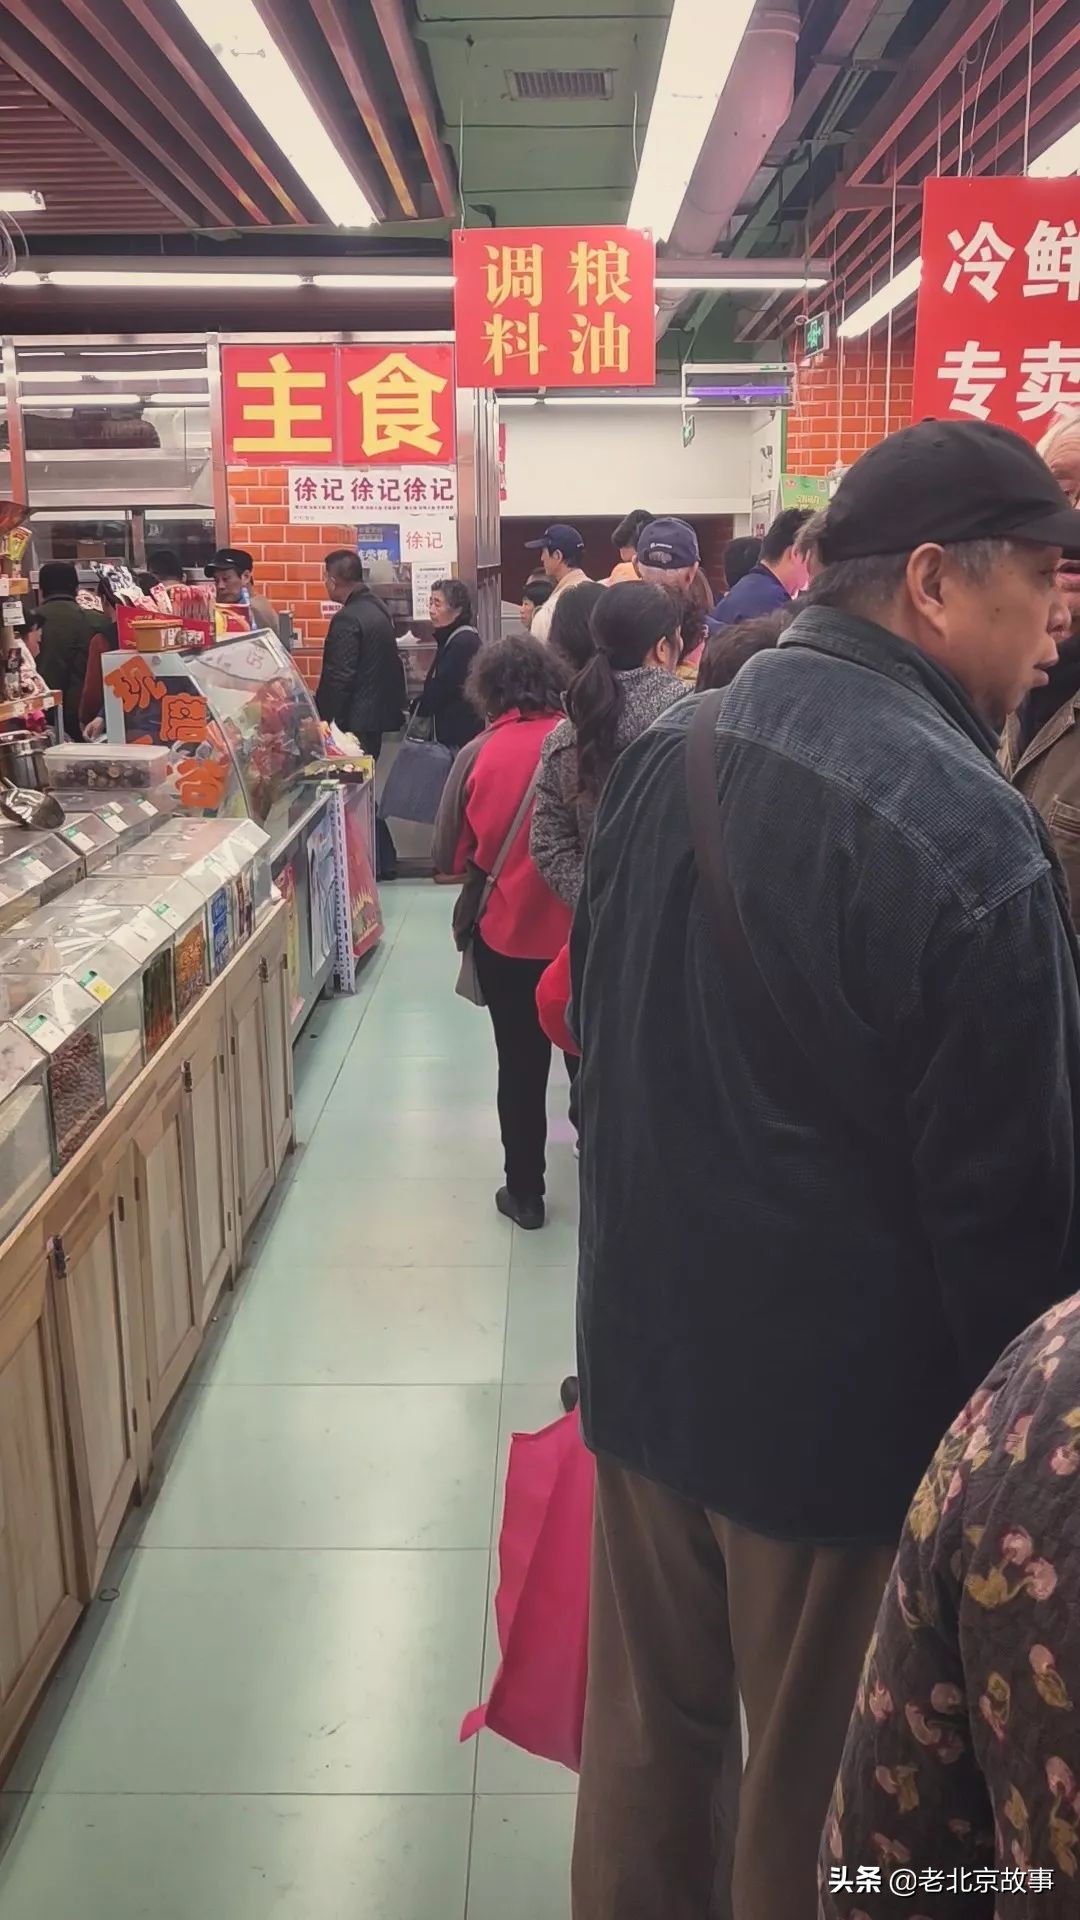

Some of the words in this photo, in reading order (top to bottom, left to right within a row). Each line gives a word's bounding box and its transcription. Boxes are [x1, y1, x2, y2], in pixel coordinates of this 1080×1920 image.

[943, 219, 1080, 304] 冷鲜
[233, 352, 448, 457] 主食
[937, 340, 1080, 422] 专卖
[294, 476, 345, 502] 徐记
[350, 477, 401, 502] 徐记
[403, 477, 454, 502] 徐记
[406, 531, 444, 550] 徐记
